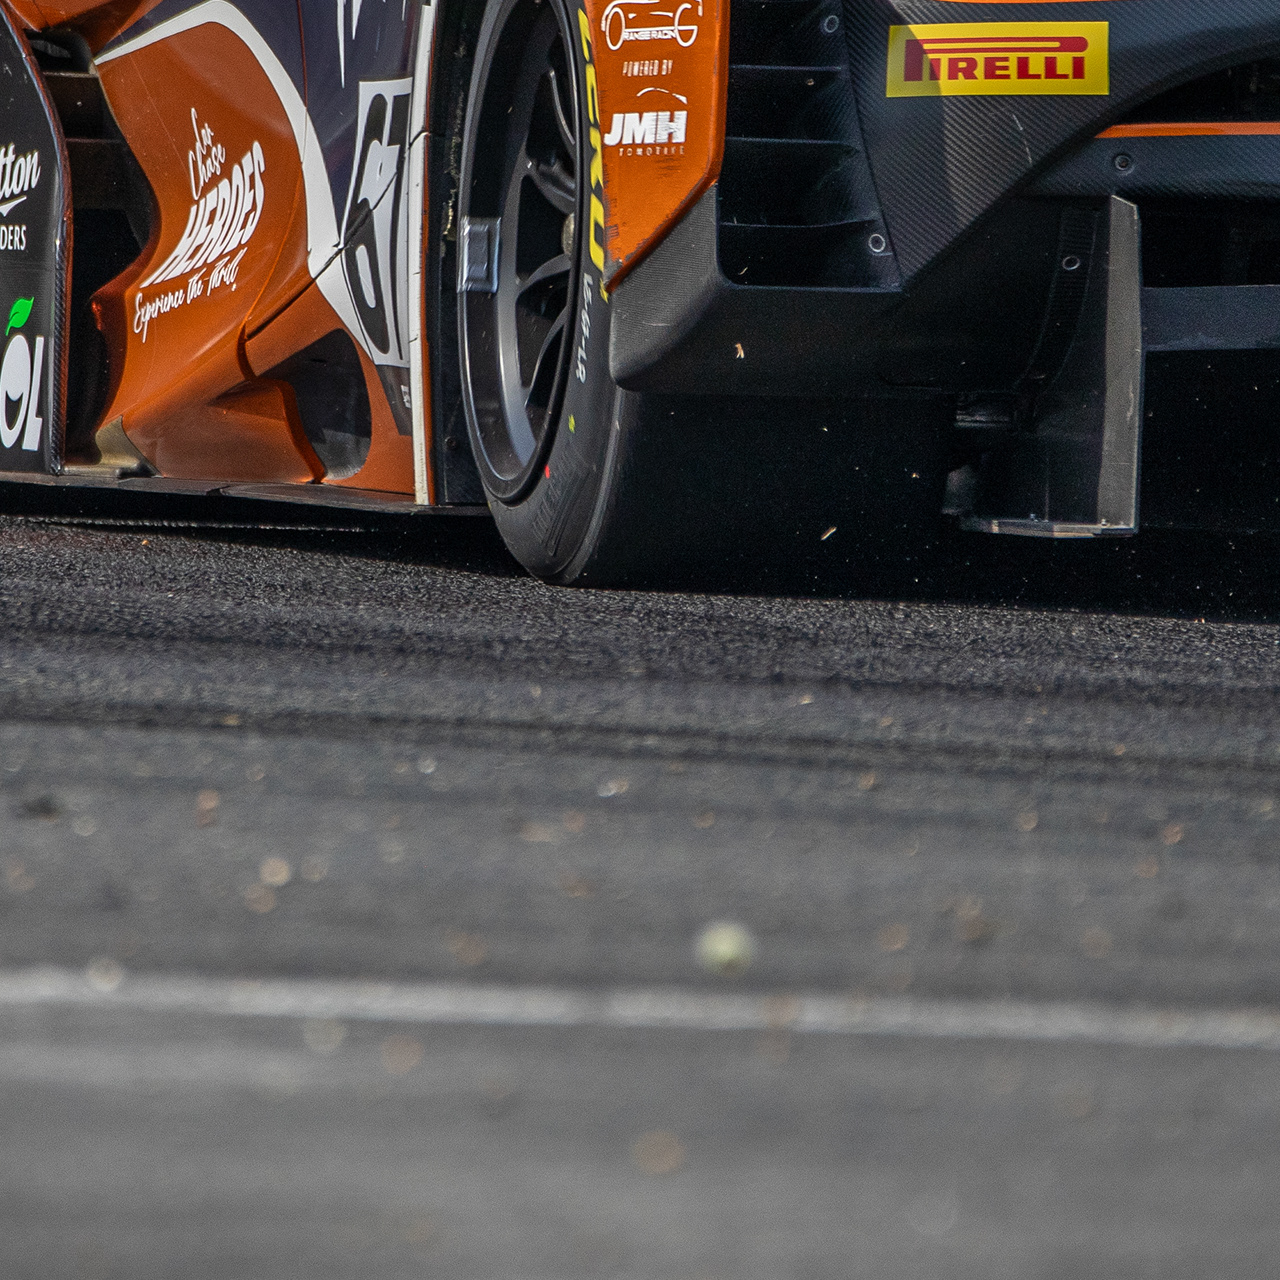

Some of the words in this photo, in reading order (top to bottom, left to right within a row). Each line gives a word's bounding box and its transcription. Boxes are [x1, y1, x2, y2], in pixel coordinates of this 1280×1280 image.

[622, 60, 660, 77] POWERED
[661, 59, 674, 76] BY
[903, 36, 1090, 82] PIRELLI
[603, 110, 688, 146] JMH
[188, 141, 226, 201] Chase
[139, 140, 266, 289] HEROES
[133, 291, 185, 344] Experience
